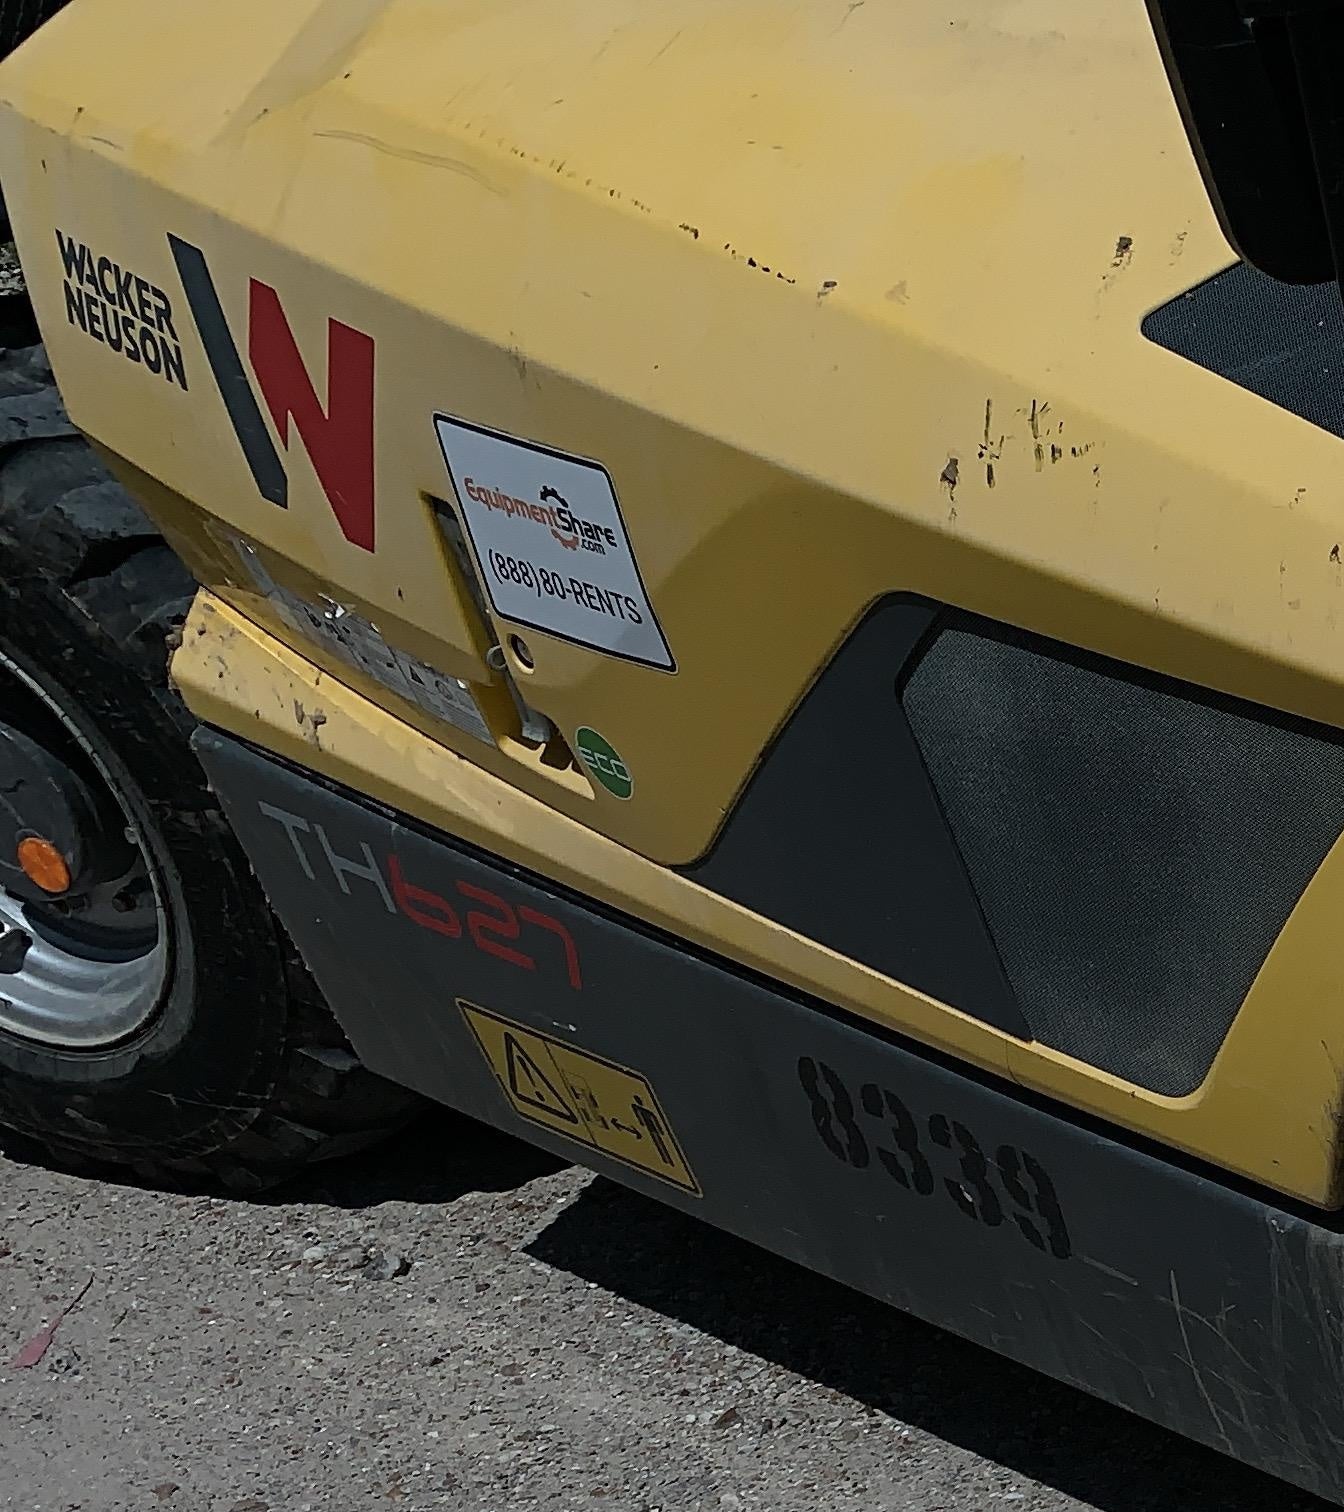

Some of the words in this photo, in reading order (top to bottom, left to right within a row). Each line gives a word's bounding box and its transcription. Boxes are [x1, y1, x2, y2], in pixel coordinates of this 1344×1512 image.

[55, 228, 179, 342] WACKER
[64, 279, 188, 392] NEUSON
[464, 477, 617, 548] EquipmentShare
[578, 745, 632, 782] ECO
[797, 1056, 1072, 1260] 8339
